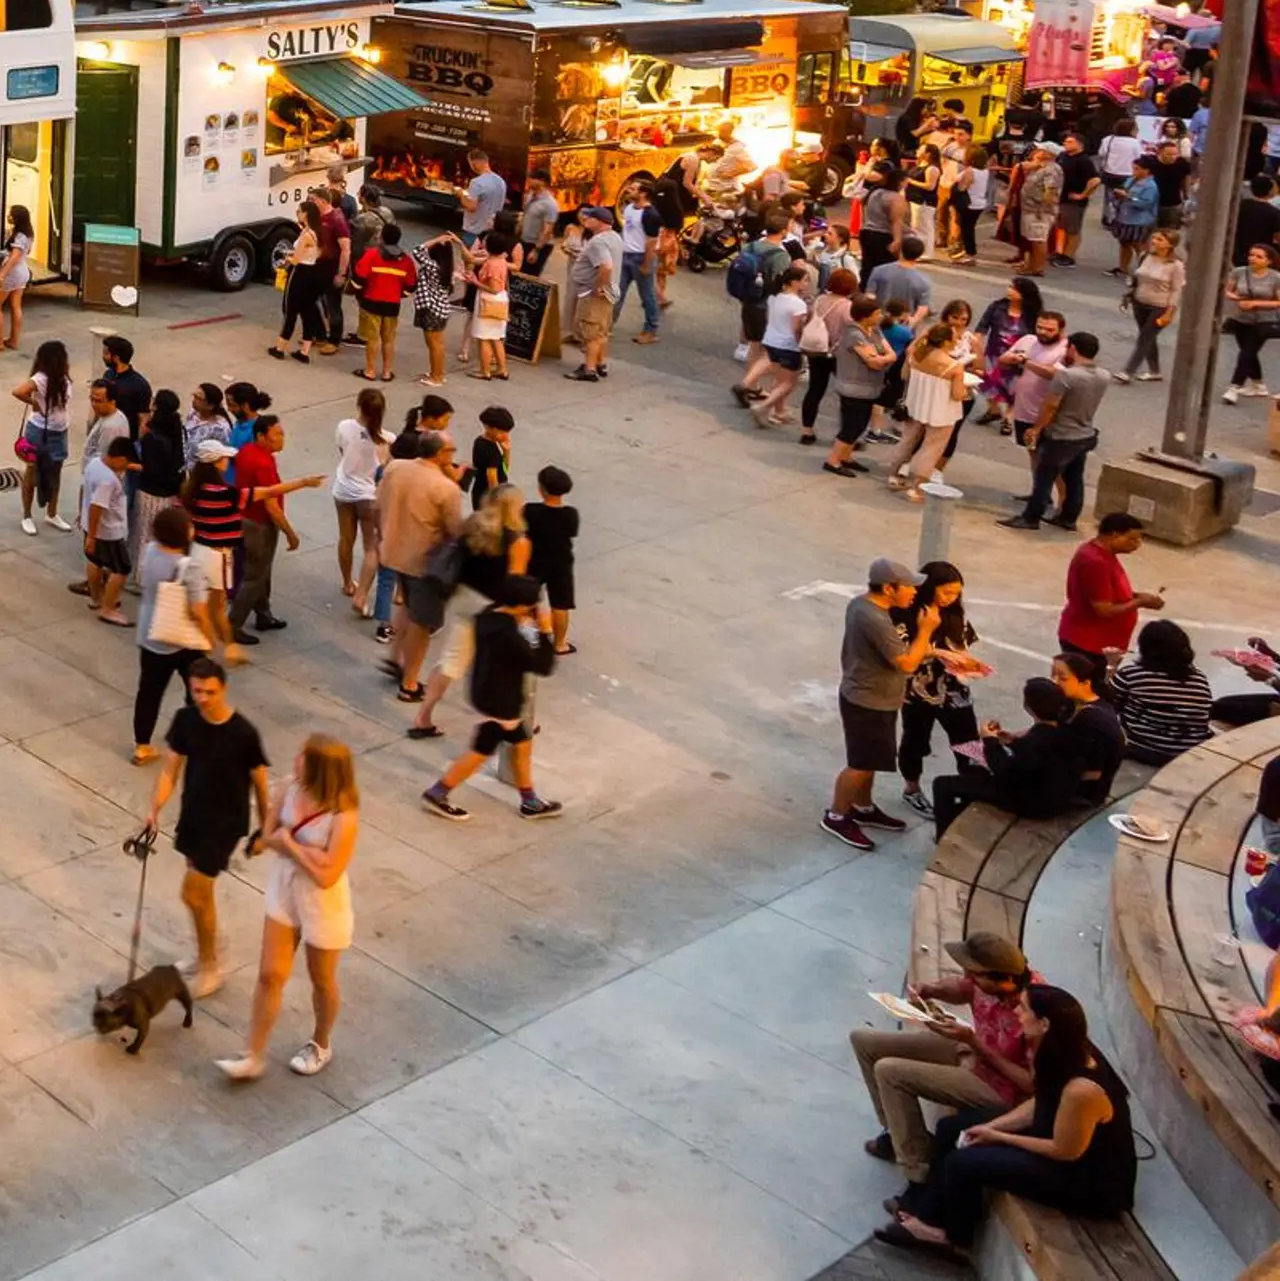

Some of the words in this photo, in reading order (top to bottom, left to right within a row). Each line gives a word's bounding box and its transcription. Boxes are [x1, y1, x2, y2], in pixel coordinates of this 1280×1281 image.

[267, 22, 359, 59] SALTY'S
[407, 62, 494, 96] BBQ
[733, 73, 790, 95] BBQ
